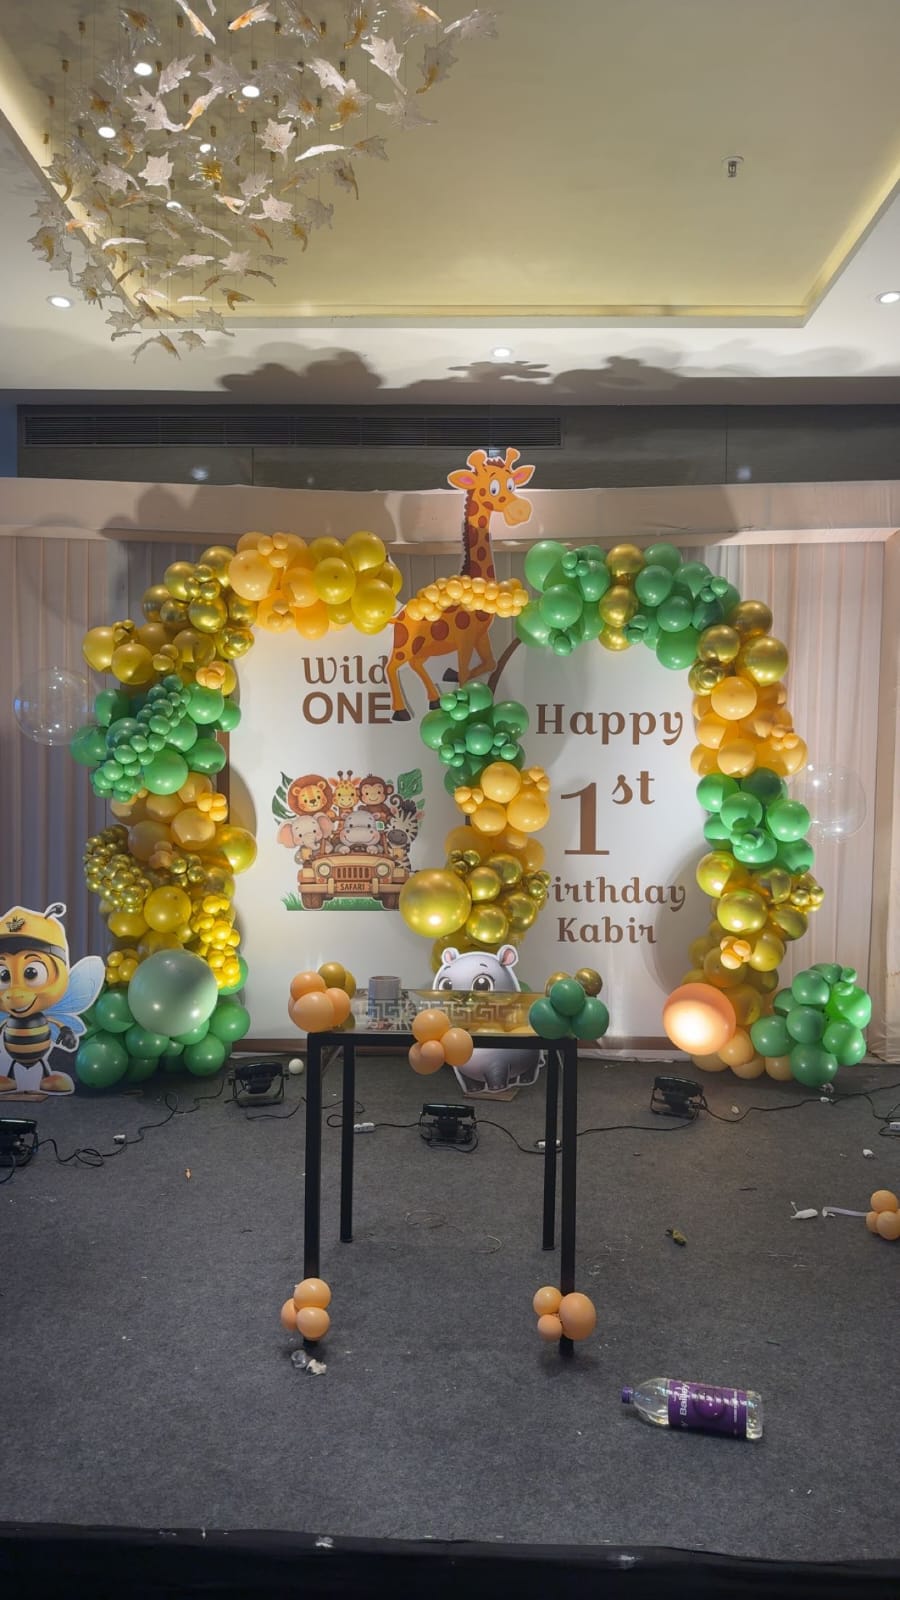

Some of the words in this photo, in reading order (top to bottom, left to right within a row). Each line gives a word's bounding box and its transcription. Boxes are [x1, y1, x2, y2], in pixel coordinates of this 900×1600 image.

[302, 655, 388, 684] Wild
[302, 691, 392, 724] ONE
[535, 703, 683, 745] Happy
[560, 771, 655, 855] 1st
[340, 883, 365, 891] SAFARI
[547, 876, 686, 912] irthday
[557, 916, 657, 943] Kabir
